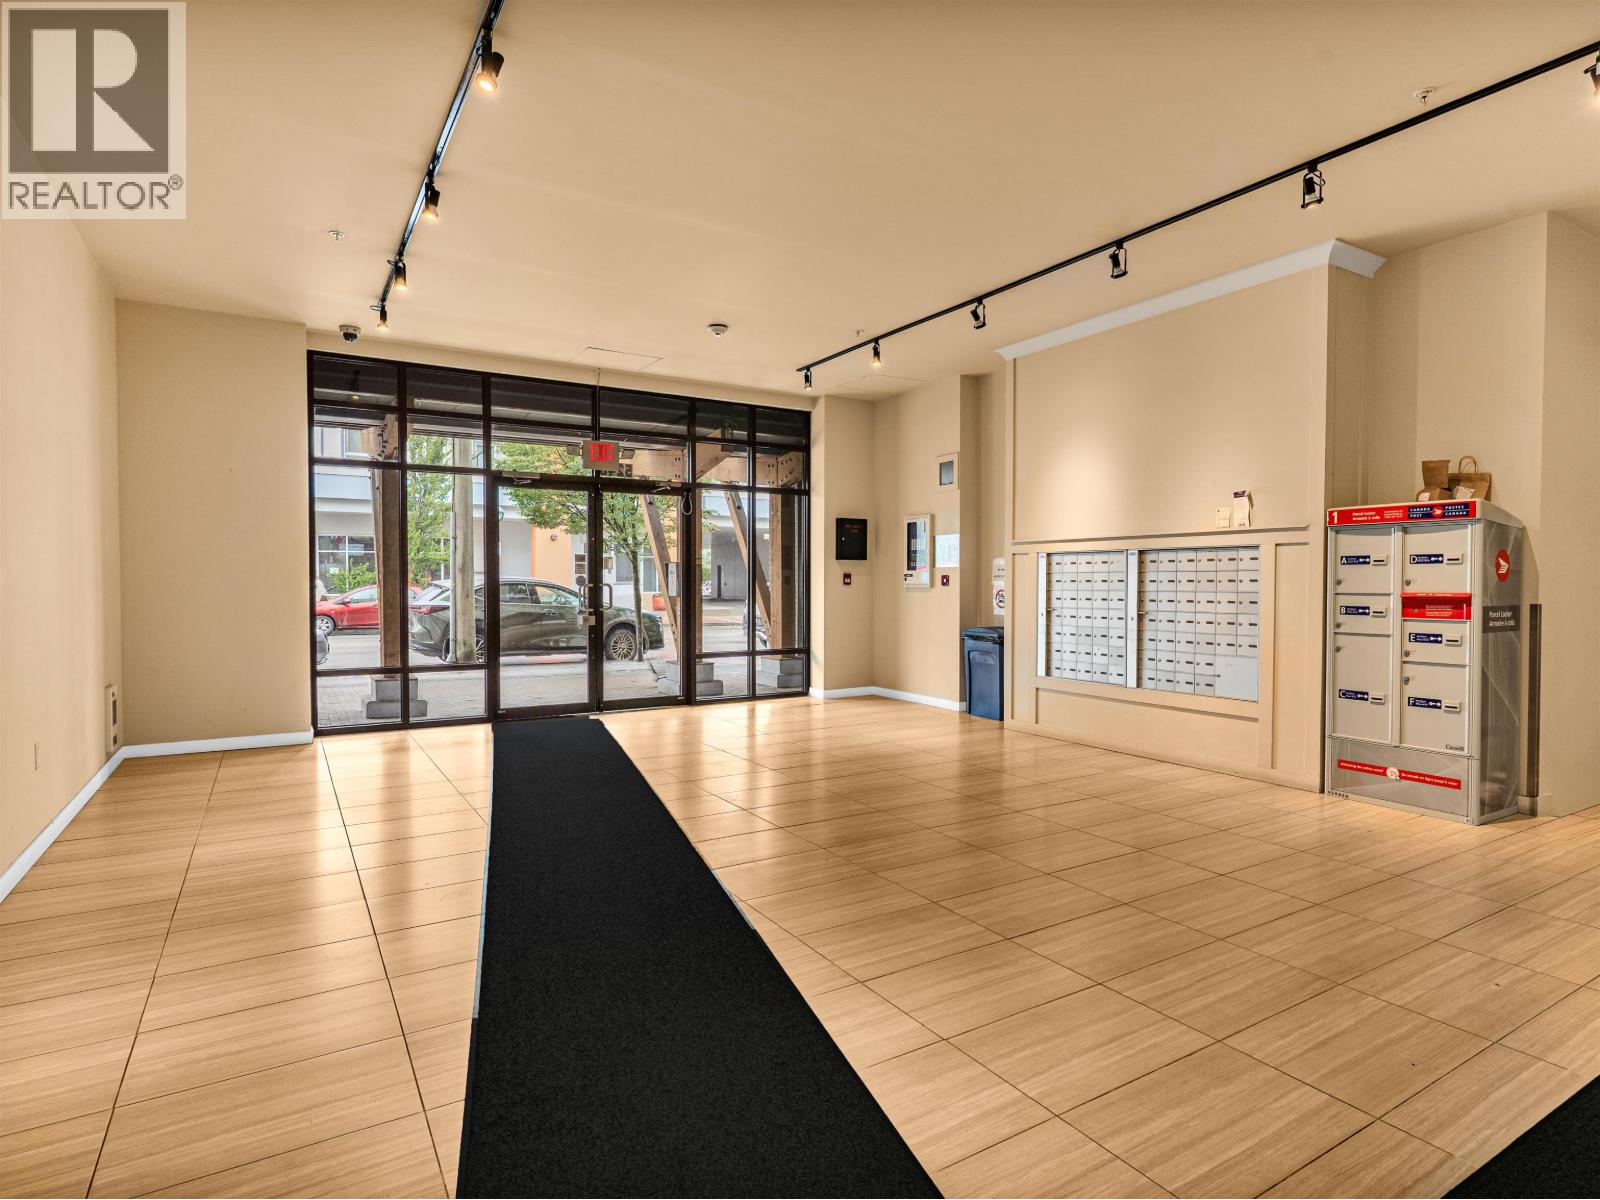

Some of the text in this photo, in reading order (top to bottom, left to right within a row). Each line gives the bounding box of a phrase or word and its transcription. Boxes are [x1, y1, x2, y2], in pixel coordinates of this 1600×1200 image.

[590, 442, 615, 464] EXIT
[1332, 511, 1338, 524] 1
[1341, 556, 1348, 564] A
[1410, 555, 1418, 564] D
[1340, 606, 1346, 614] B
[1410, 633, 1416, 642] E
[1339, 690, 1346, 698] C
[1409, 697, 1415, 706] F
